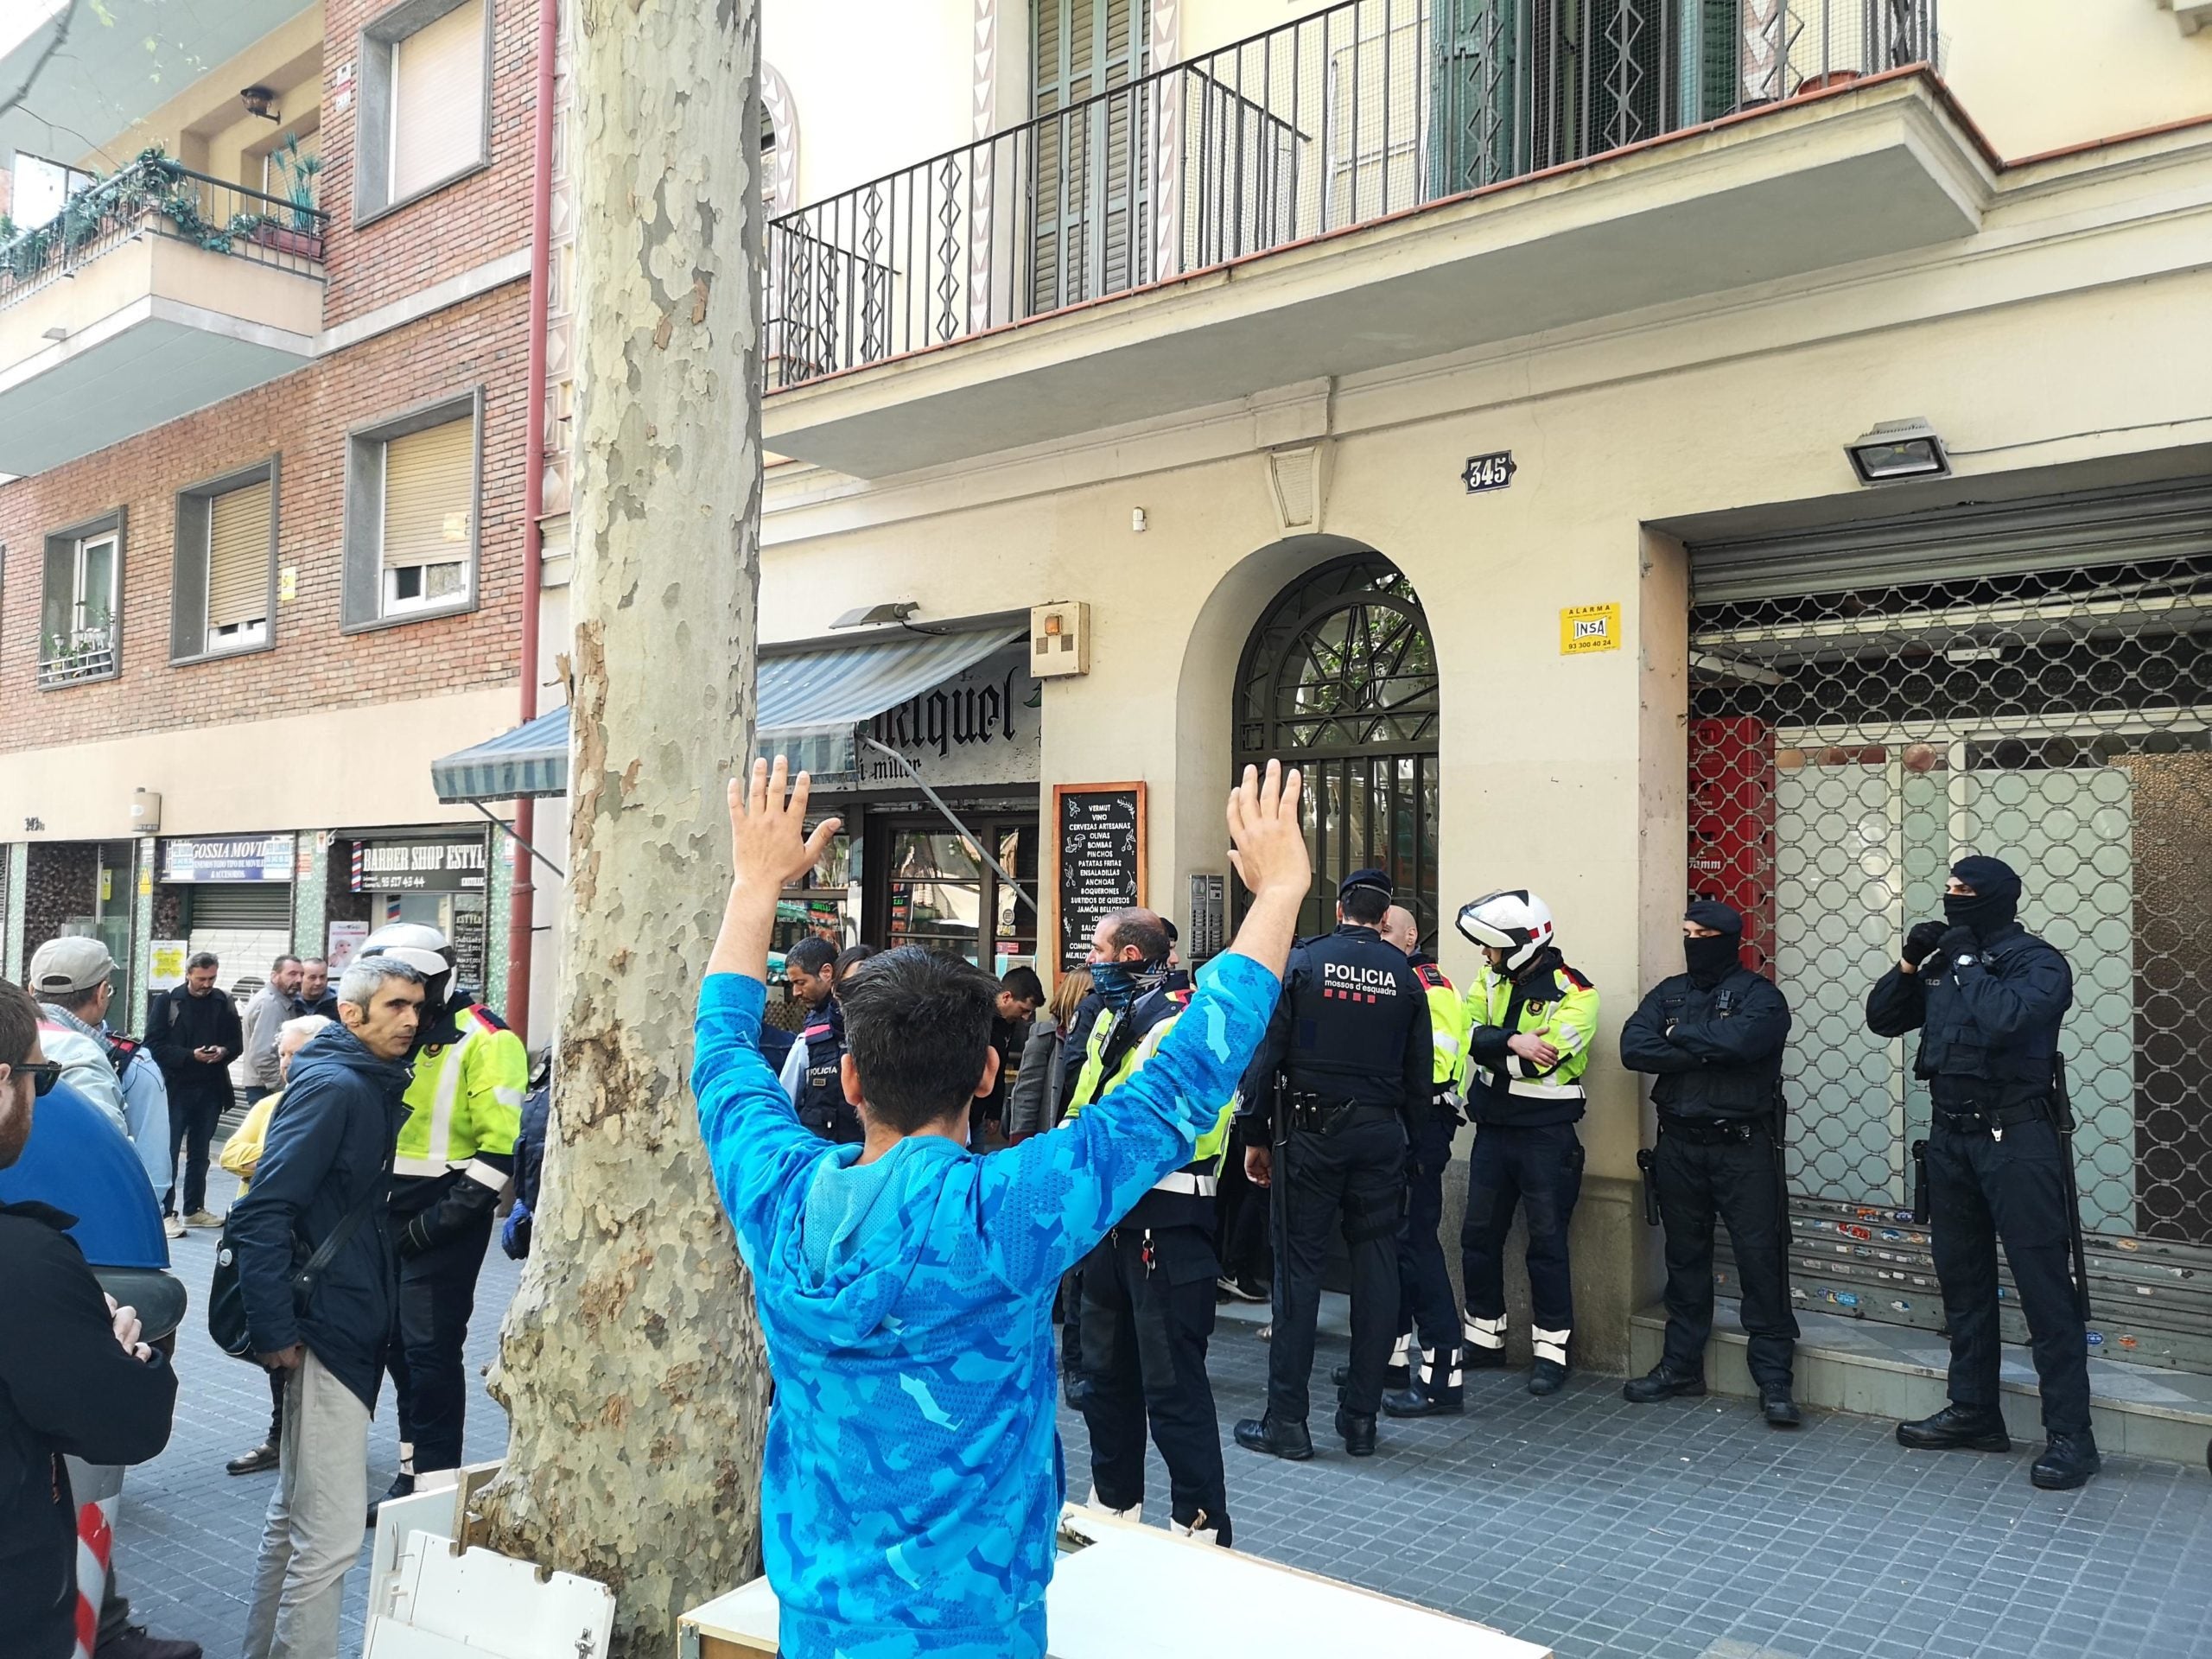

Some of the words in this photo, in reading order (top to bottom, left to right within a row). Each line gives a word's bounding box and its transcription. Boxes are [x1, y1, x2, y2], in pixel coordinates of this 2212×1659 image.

[1470, 456, 1507, 487] 345
[1568, 605, 1611, 614] ALARMA
[1576, 620, 1605, 637] INSA
[193, 842, 230, 858] GOSSIA
[363, 849, 409, 872] BARBER
[411, 846, 444, 870] SHOP
[1077, 905, 1099, 913] JAMÓN
[1324, 963, 1396, 988] POLICIA
[1325, 979, 1354, 990] mossos
[810, 1065, 837, 1076] POLICIA
